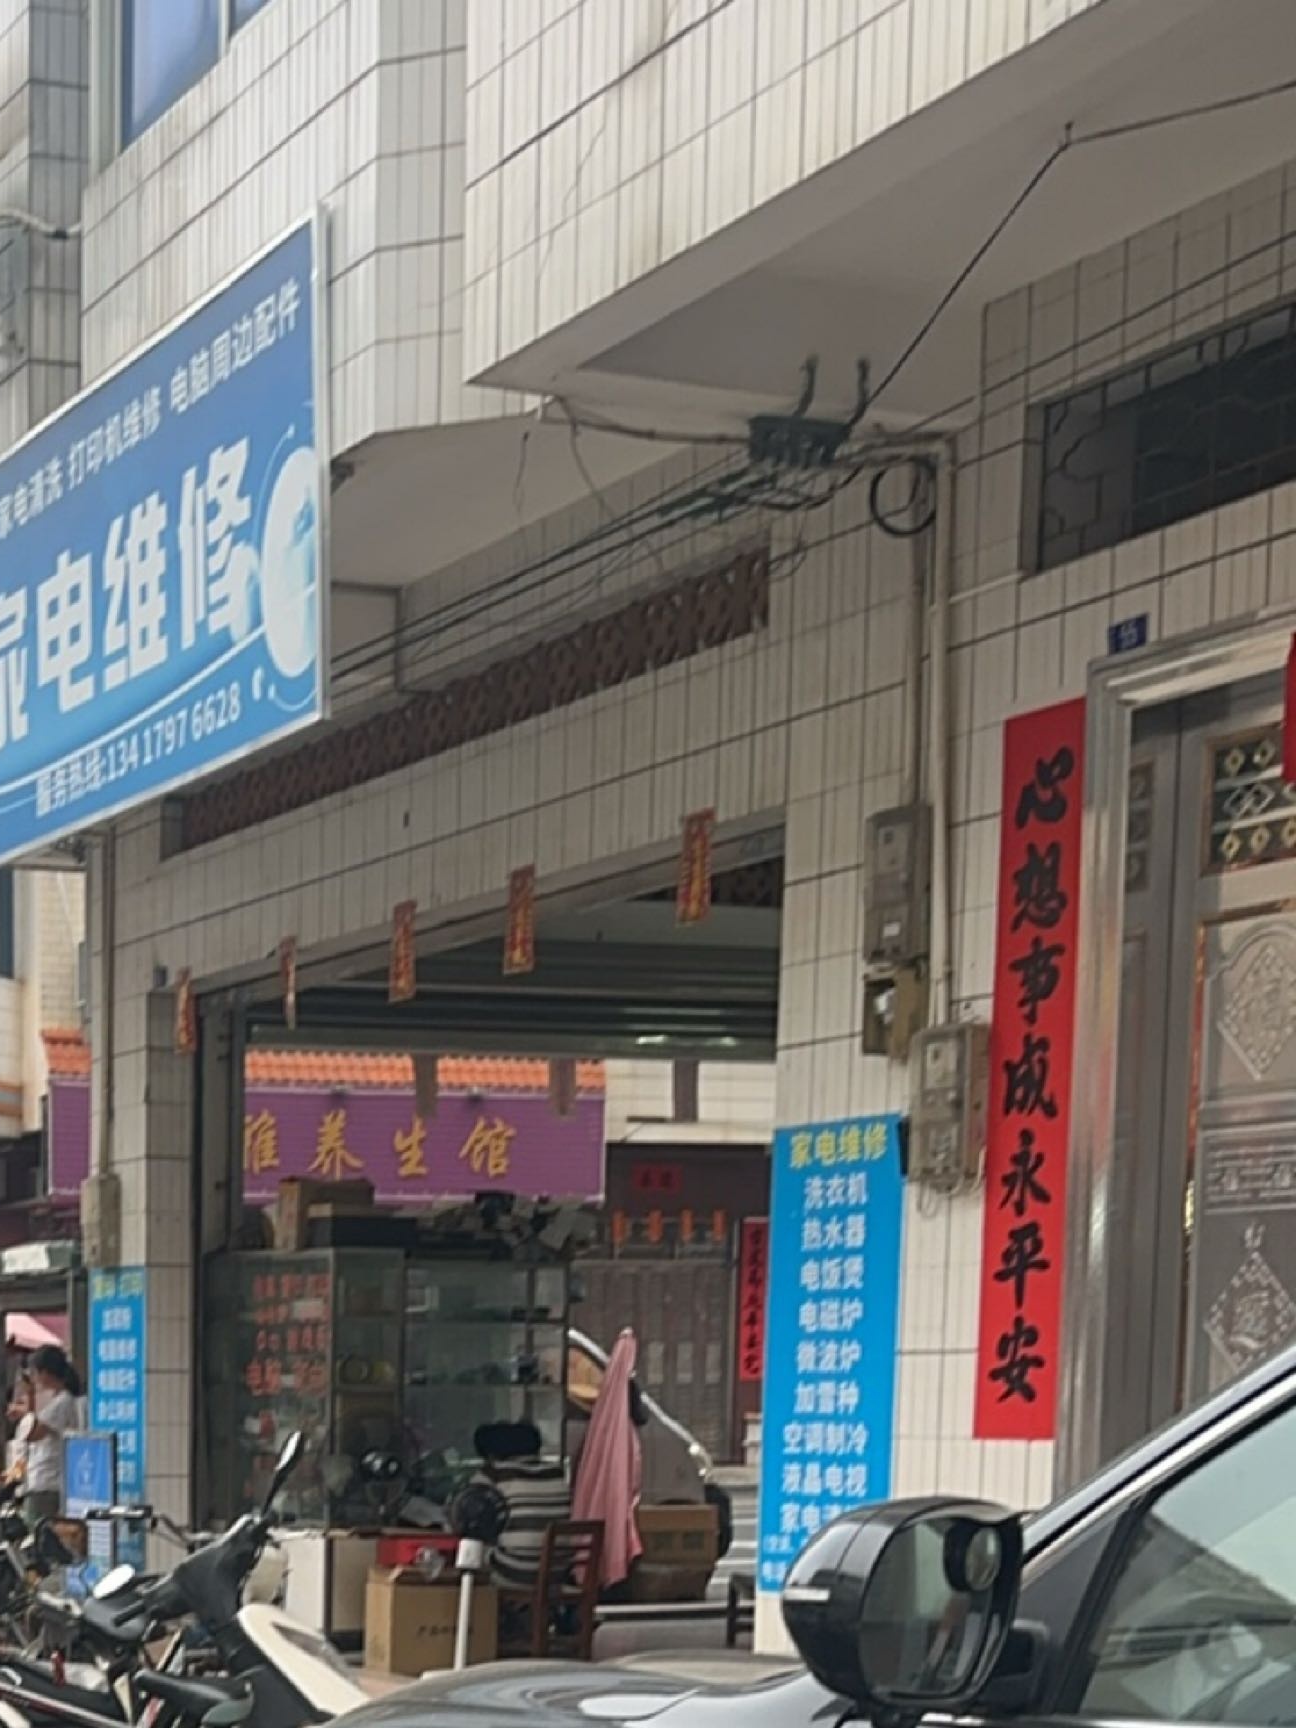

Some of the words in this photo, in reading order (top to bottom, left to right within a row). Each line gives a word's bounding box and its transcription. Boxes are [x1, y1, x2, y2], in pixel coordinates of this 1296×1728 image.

[69, 386, 161, 490] 打印机维修
[170, 278, 301, 416] 电脑周边配件
[143, 708, 187, 766] 1797
[191, 682, 242, 741] 6628
[989, 746, 1075, 1404] 心想事成永平安
[790, 1122, 887, 1169] 家电维修
[804, 1172, 867, 1211] 洗衣机
[801, 1213, 866, 1252] 热水器
[800, 1254, 864, 1292] 电饭煲
[799, 1297, 863, 1333] 电磁炉
[797, 1339, 862, 1375] 微波炉
[783, 1421, 869, 1456] 空调制冷
[782, 1463, 868, 1497] 液晶电视
